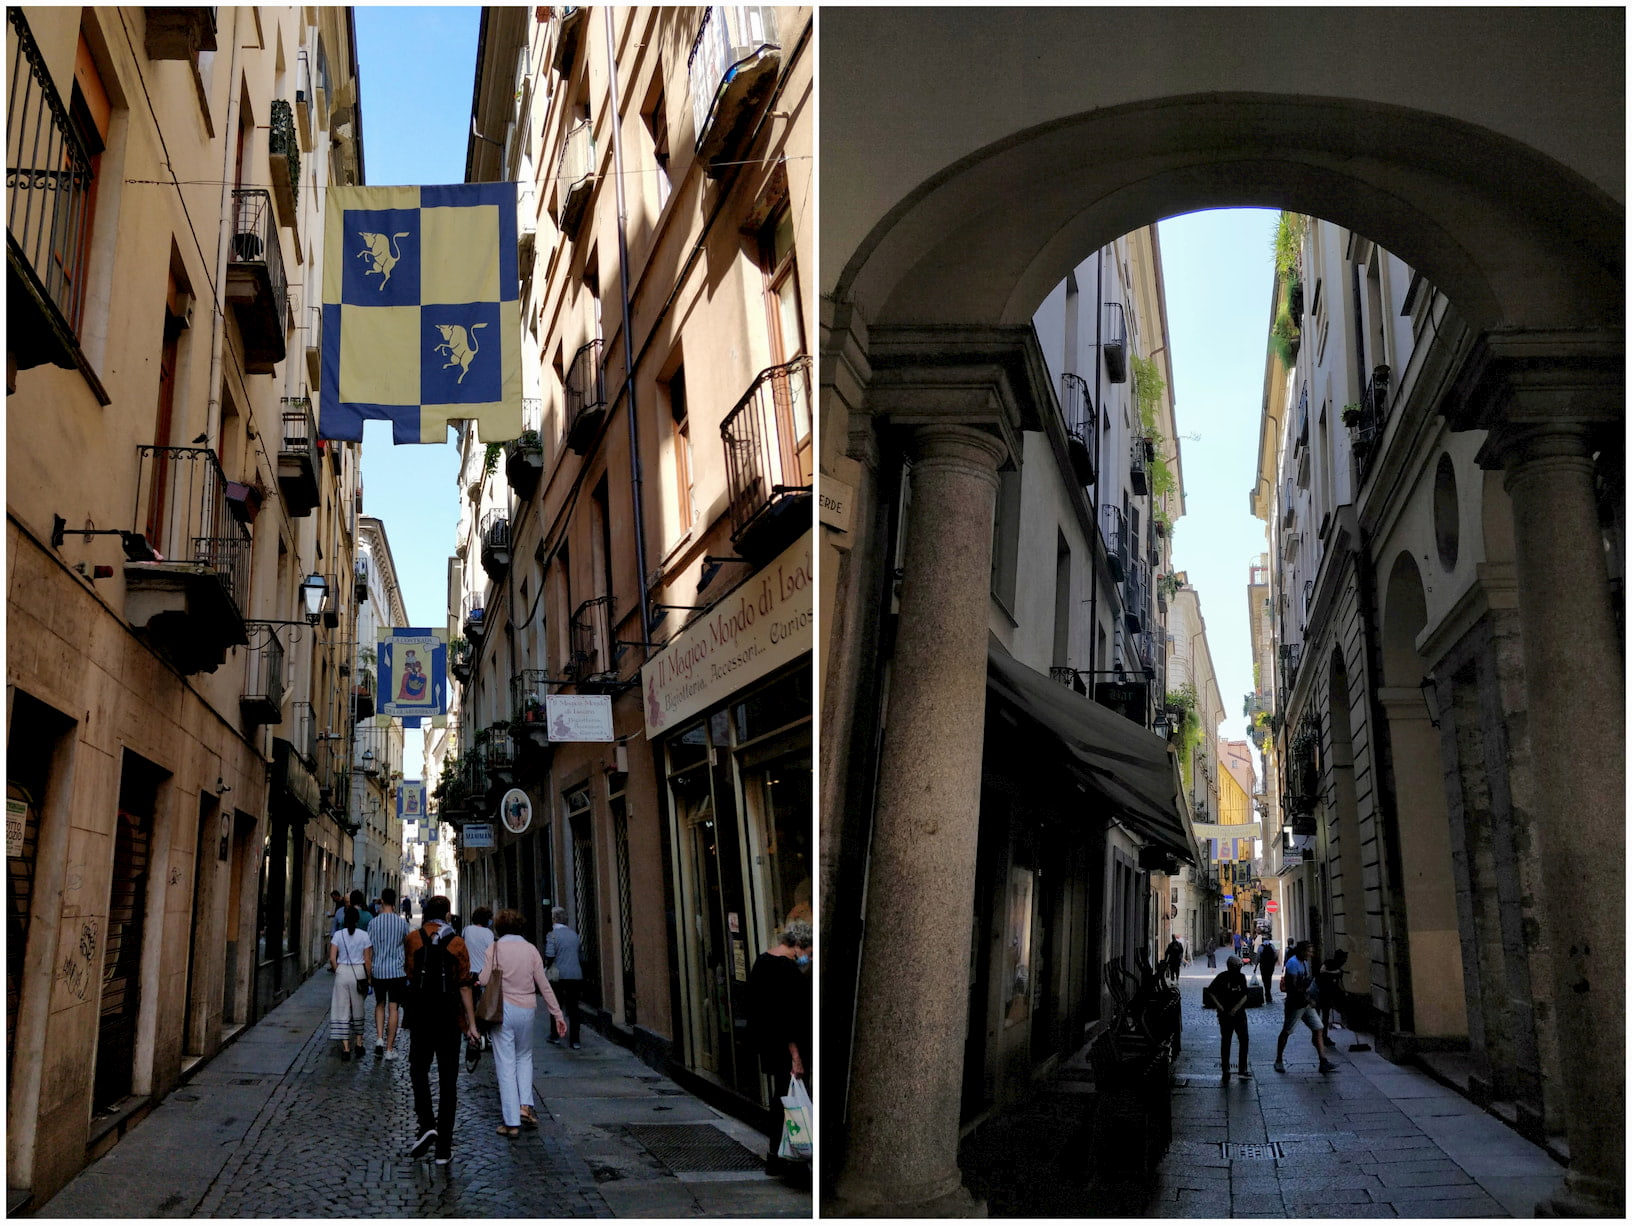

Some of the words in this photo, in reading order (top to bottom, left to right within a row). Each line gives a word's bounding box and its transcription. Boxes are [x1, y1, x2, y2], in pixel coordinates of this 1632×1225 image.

[658, 659, 666, 689] Il
[667, 636, 708, 682] Magico
[709, 596, 755, 652] Mondo
[759, 575, 773, 616] di
